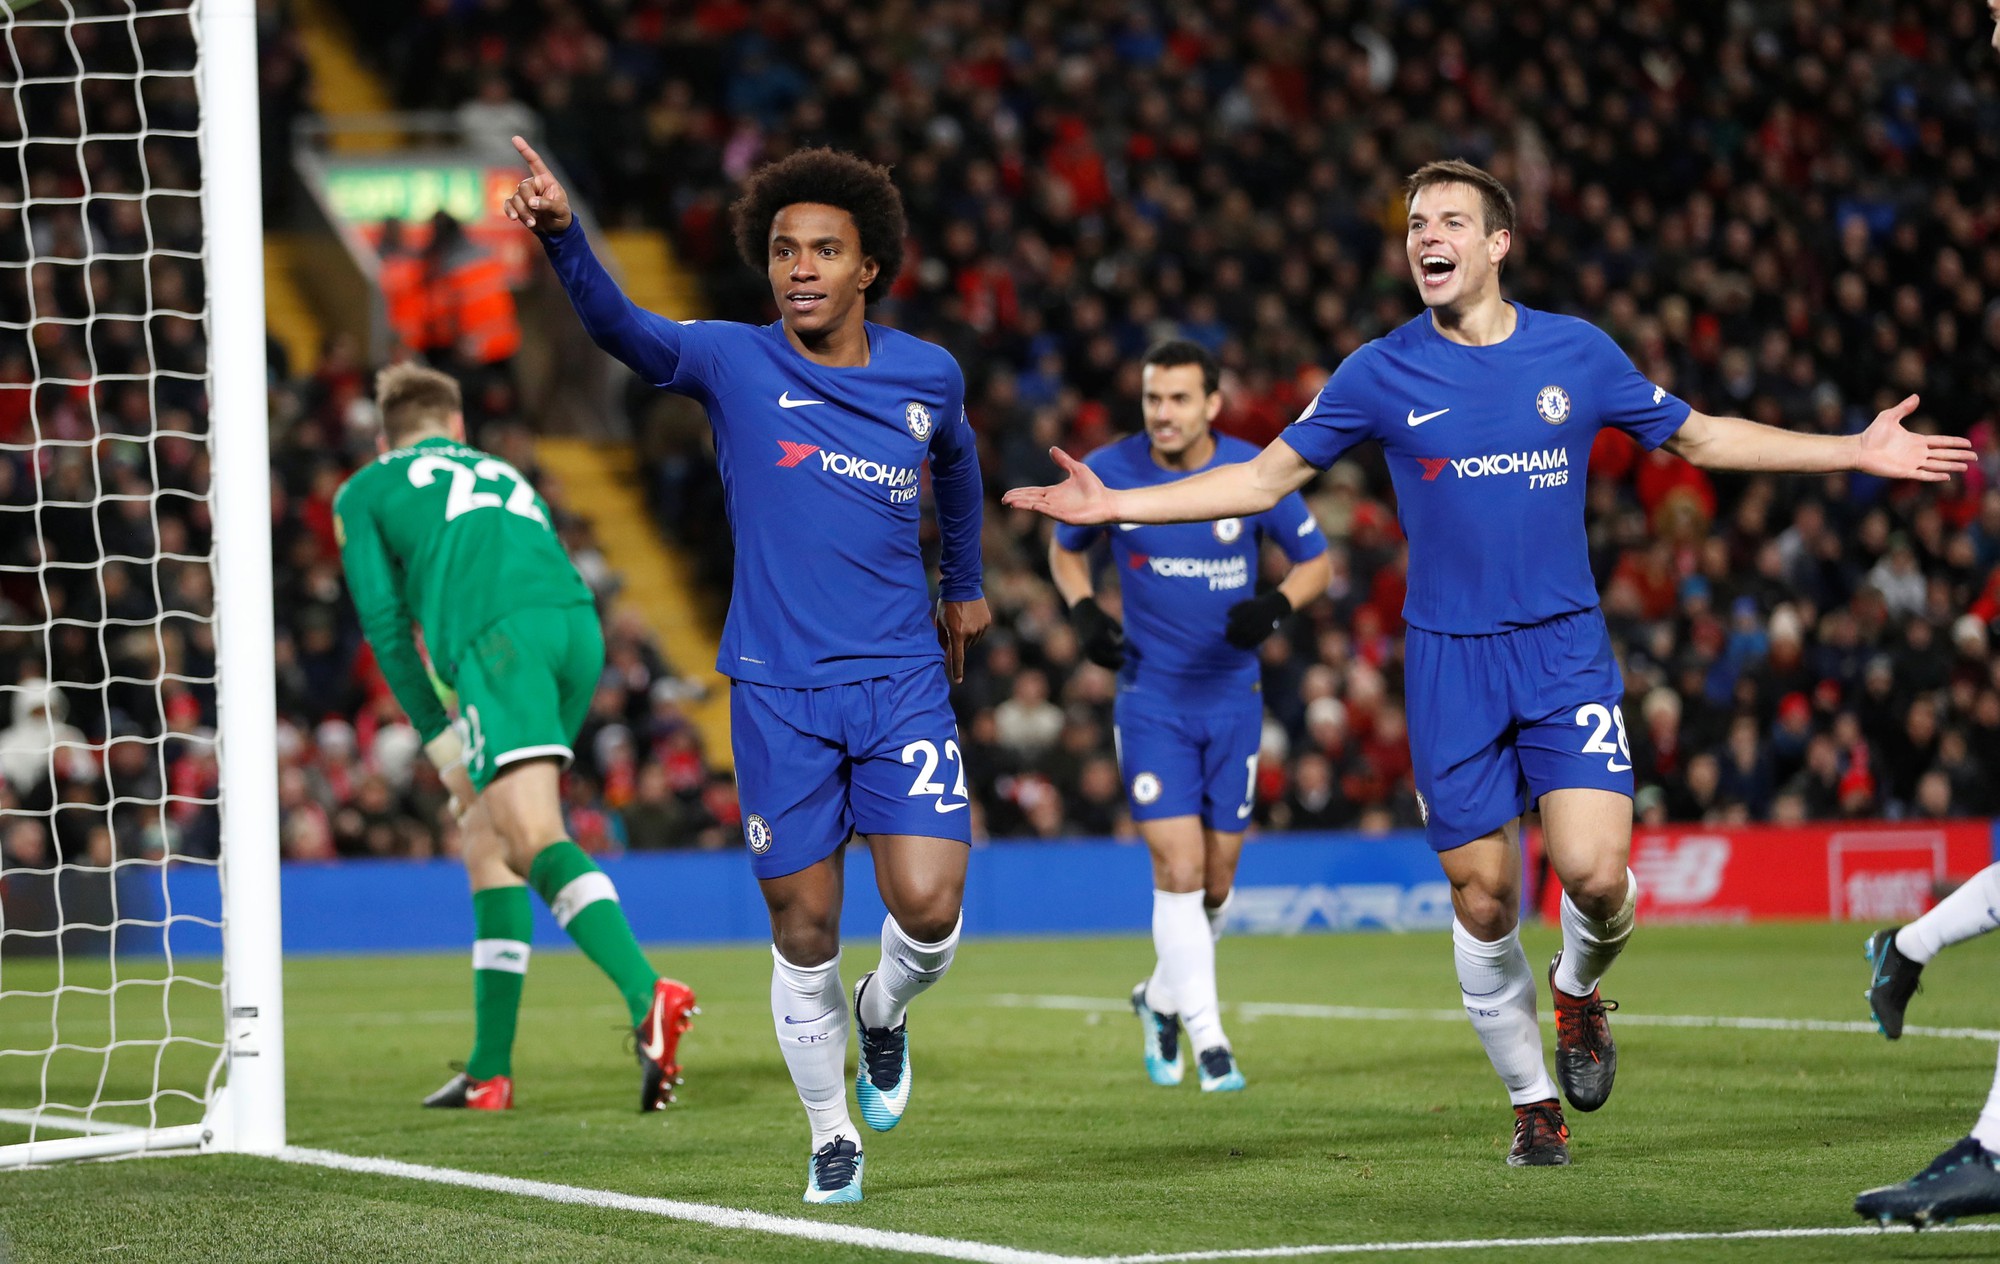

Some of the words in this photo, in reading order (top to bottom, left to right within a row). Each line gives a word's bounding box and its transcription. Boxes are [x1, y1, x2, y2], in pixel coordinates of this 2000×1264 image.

[1451, 447, 1569, 478] YOKOHAMA
[1529, 470, 1569, 489] TYRES
[407, 456, 550, 531] 22
[1148, 556, 1247, 577] YOKOHAMA
[901, 739, 969, 800] 22
[1467, 1006, 1500, 1018] CFC
[797, 1032, 829, 1044] CFC
